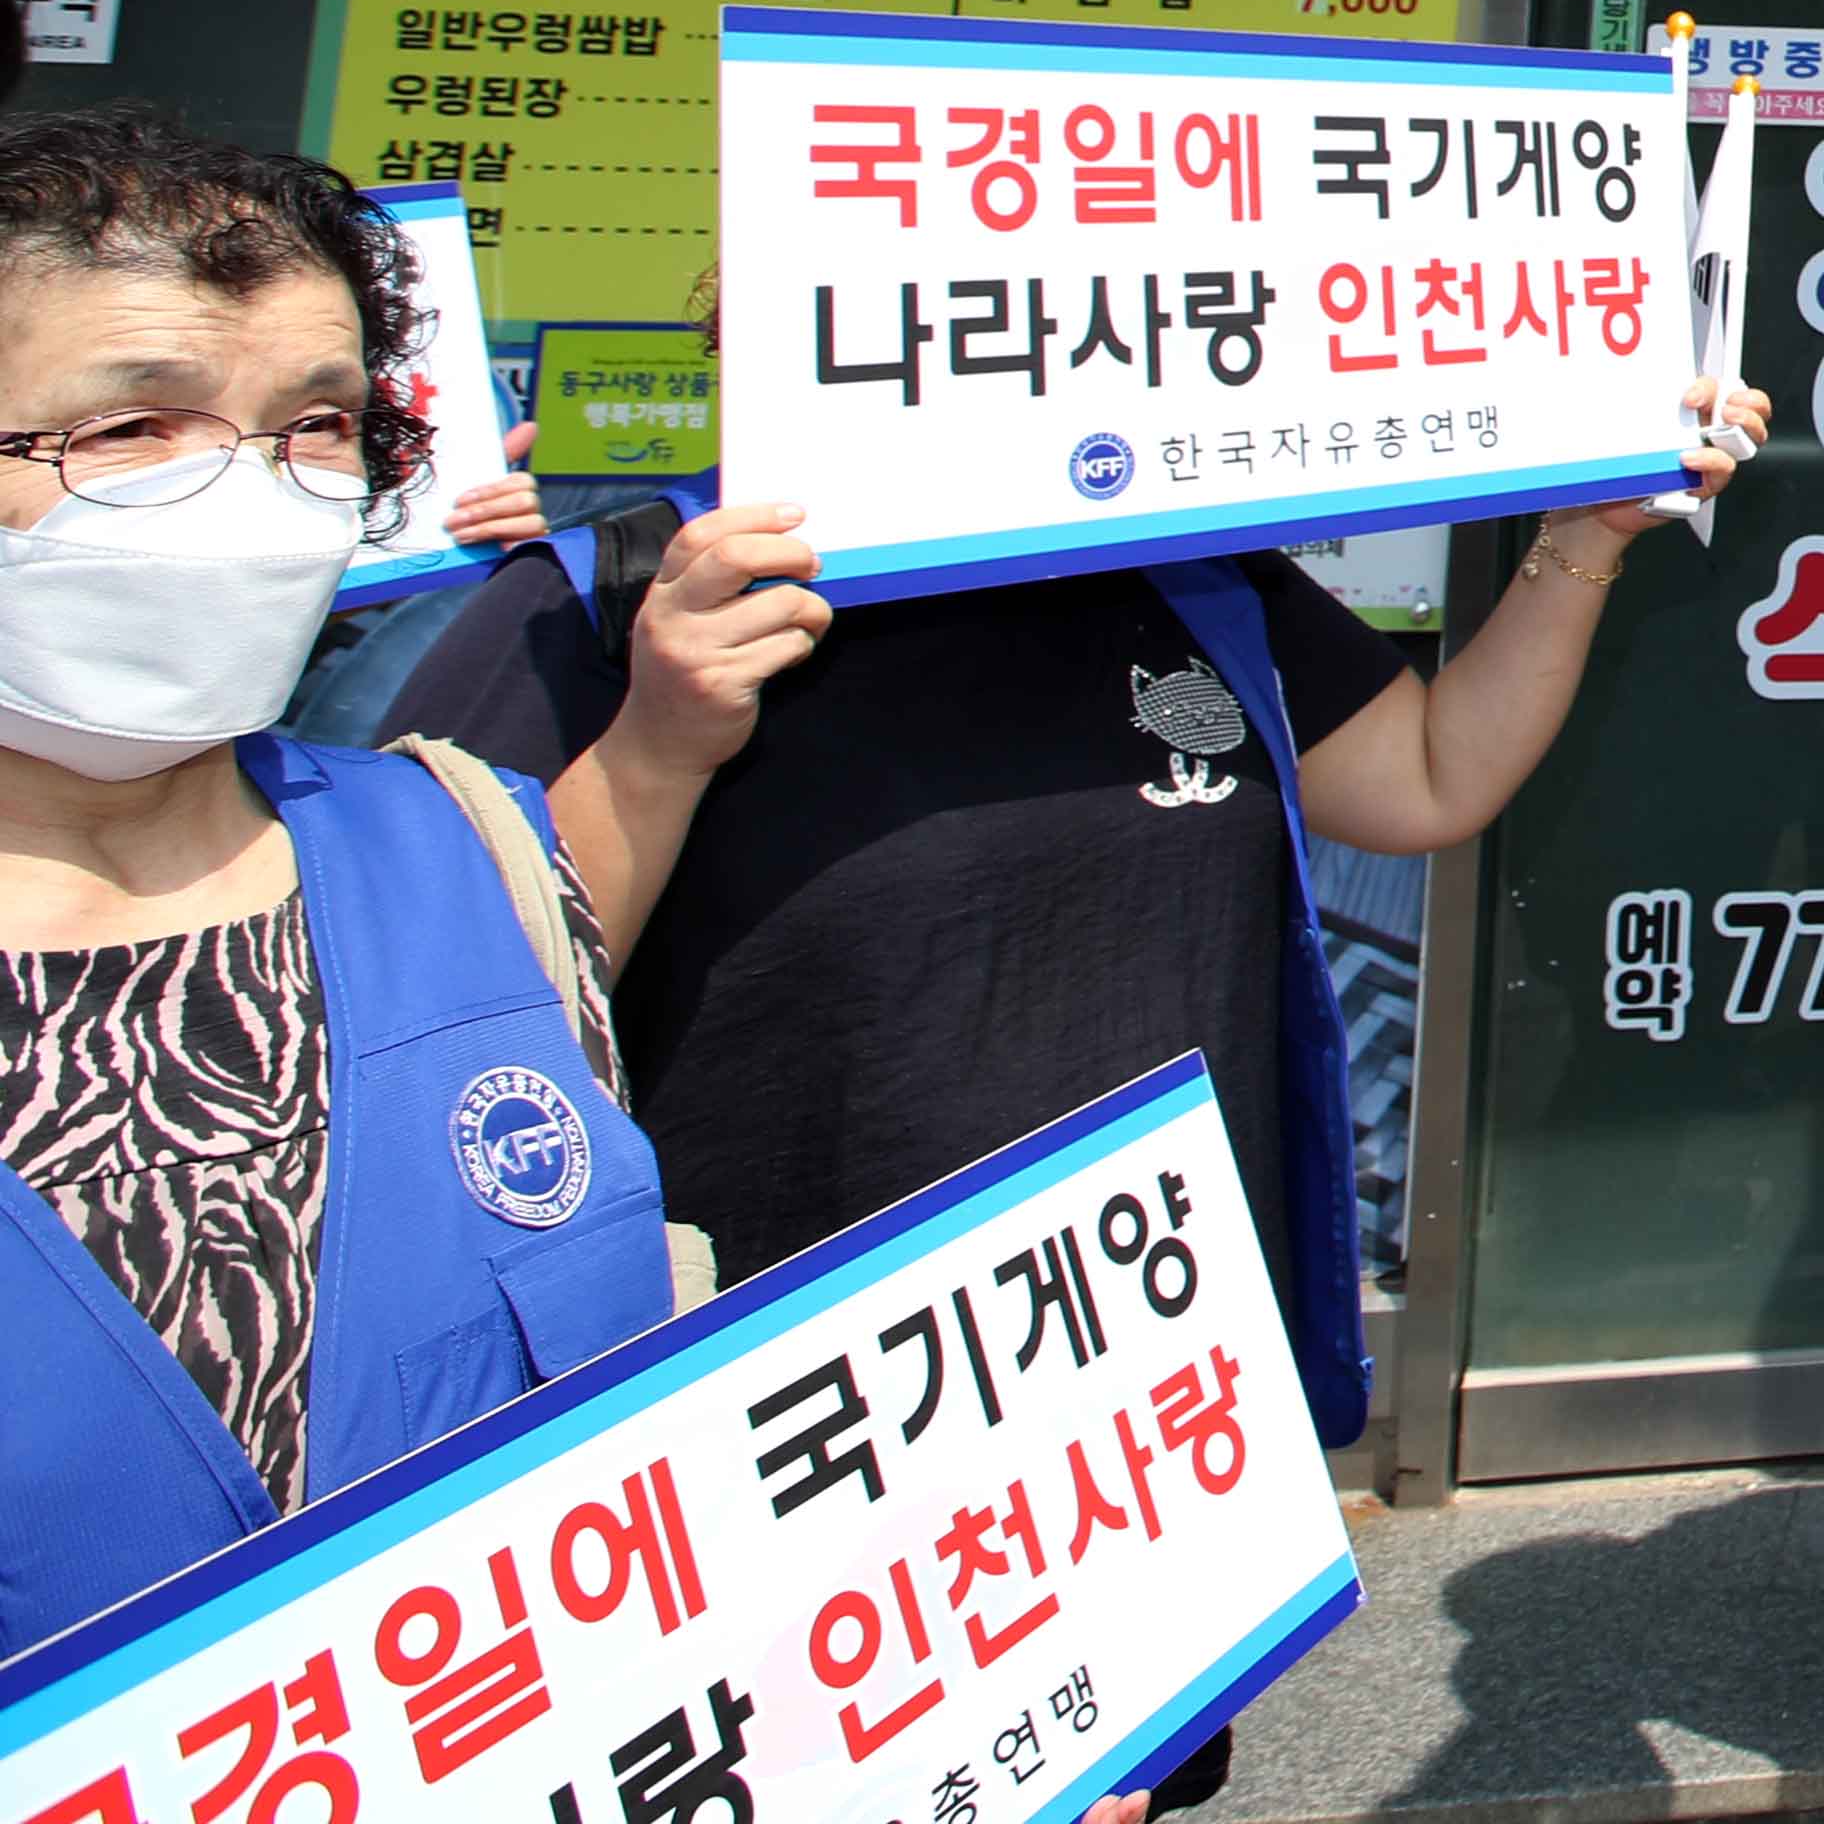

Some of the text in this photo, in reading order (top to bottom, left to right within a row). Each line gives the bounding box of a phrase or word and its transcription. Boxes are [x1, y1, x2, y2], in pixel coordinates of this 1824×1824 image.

[396, 9, 665, 56] 일반우렁쌈밥
[386, 75, 567, 118] 우렁된장
[376, 141, 515, 182] 삼겹살
[811, 104, 1643, 234] 국경일에 국기게양
[469, 208, 503, 249] 면
[816, 257, 1652, 407] 나라사랑 인천사랑
[559, 370, 657, 397] 동구사랑
[666, 370, 719, 397] 상품
[584, 401, 709, 430] 행복가맹점
[1159, 404, 1501, 482] 한국자유총연맹
[1081, 456, 1125, 479] KFF
[1605, 889, 1693, 1040] 예약
[481, 1121, 563, 1180] KFF
[746, 1170, 1201, 1518] 국기게양
[808, 1344, 1247, 1764] 인천사랑
[885, 1664, 1099, 1824] 총연맹
